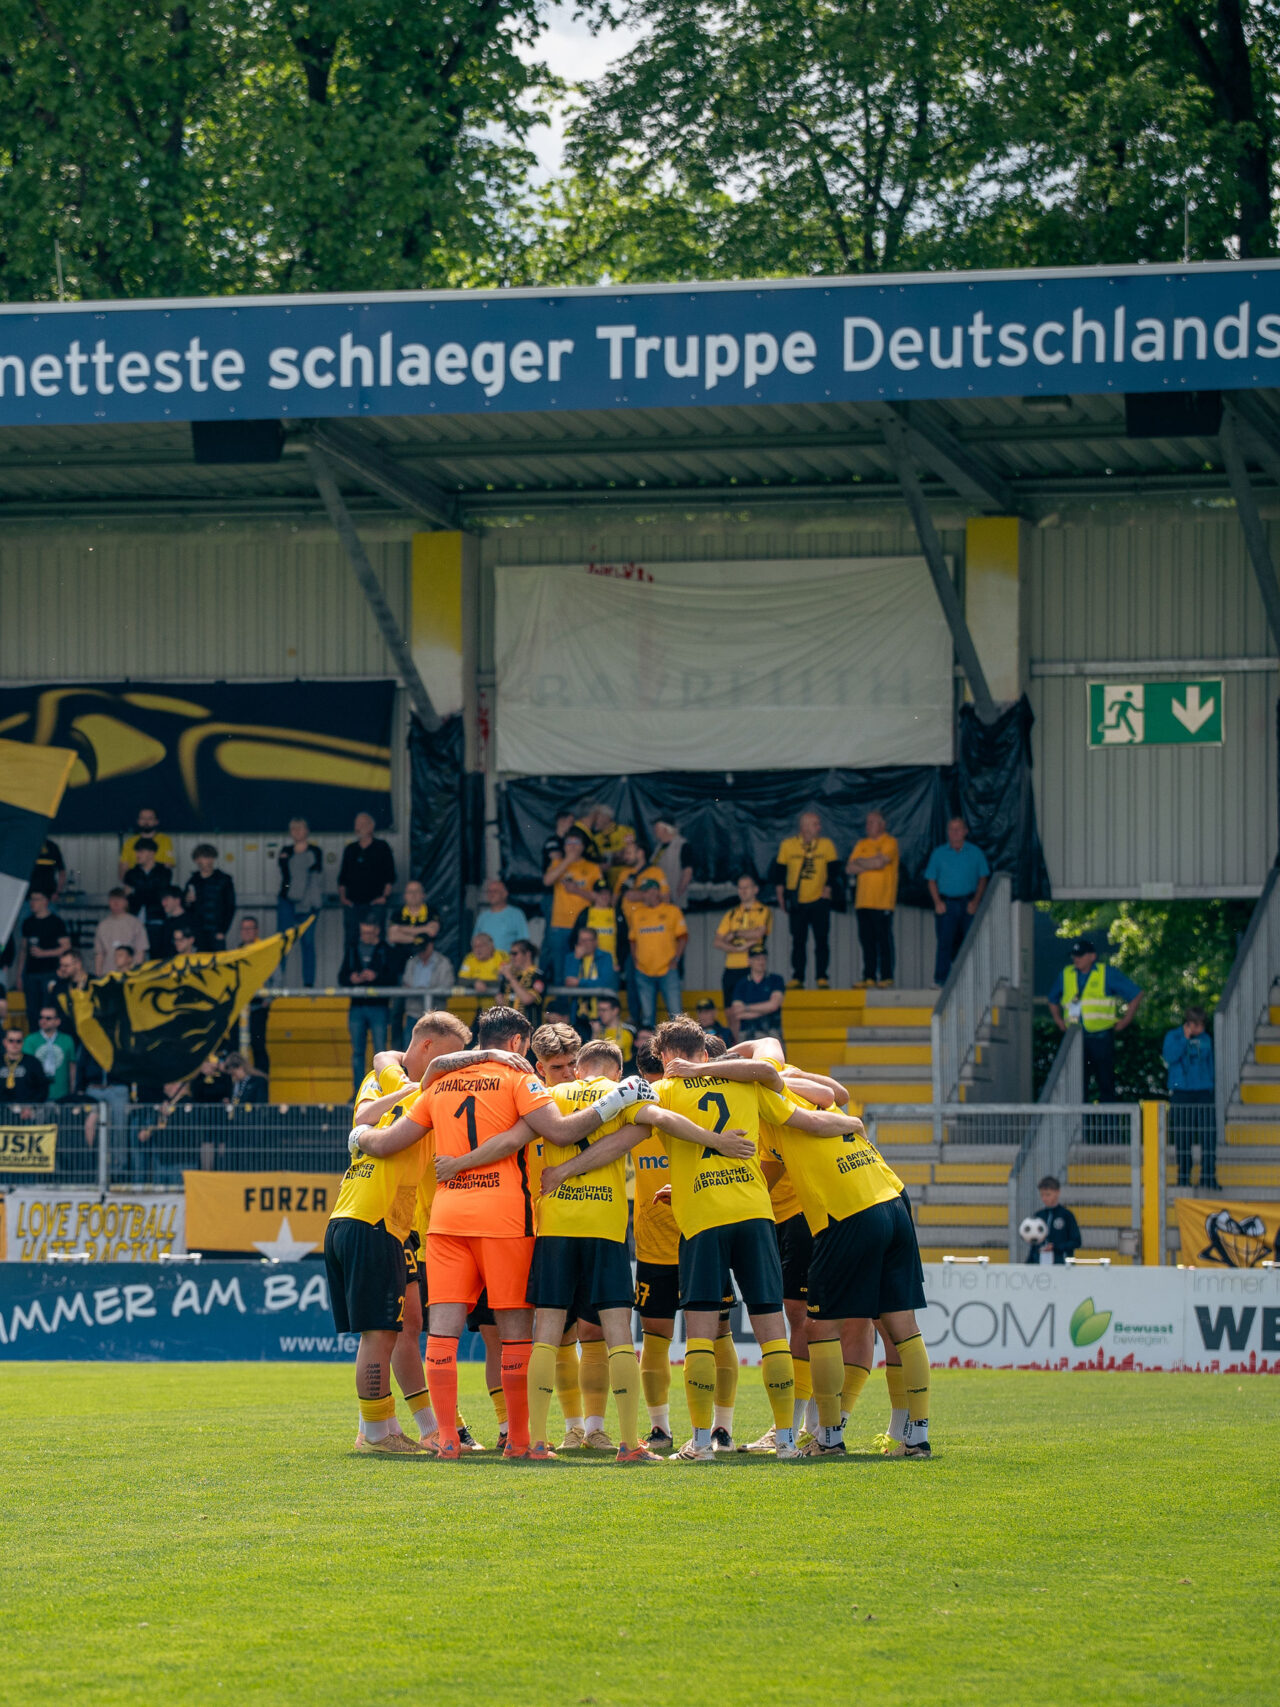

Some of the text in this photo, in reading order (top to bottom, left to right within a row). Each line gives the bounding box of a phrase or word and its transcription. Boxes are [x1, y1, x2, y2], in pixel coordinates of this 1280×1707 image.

[268, 331, 575, 398] schlaeger
[596, 325, 818, 390] Truppe
[842, 302, 1280, 373] Deutschlands
[434, 1078, 501, 1095] ZAHACZEWSKI
[448, 1180, 500, 1190] BRAUHAUS
[244, 1186, 327, 1212] FORZA
[557, 1191, 613, 1203] BRAUHAUS
[16, 1201, 178, 1241] LOVE FOOTBALL
[1193, 1271, 1268, 1294] Immer
[171, 1277, 247, 1317] AM
[1114, 1321, 1174, 1334] Bewusst
